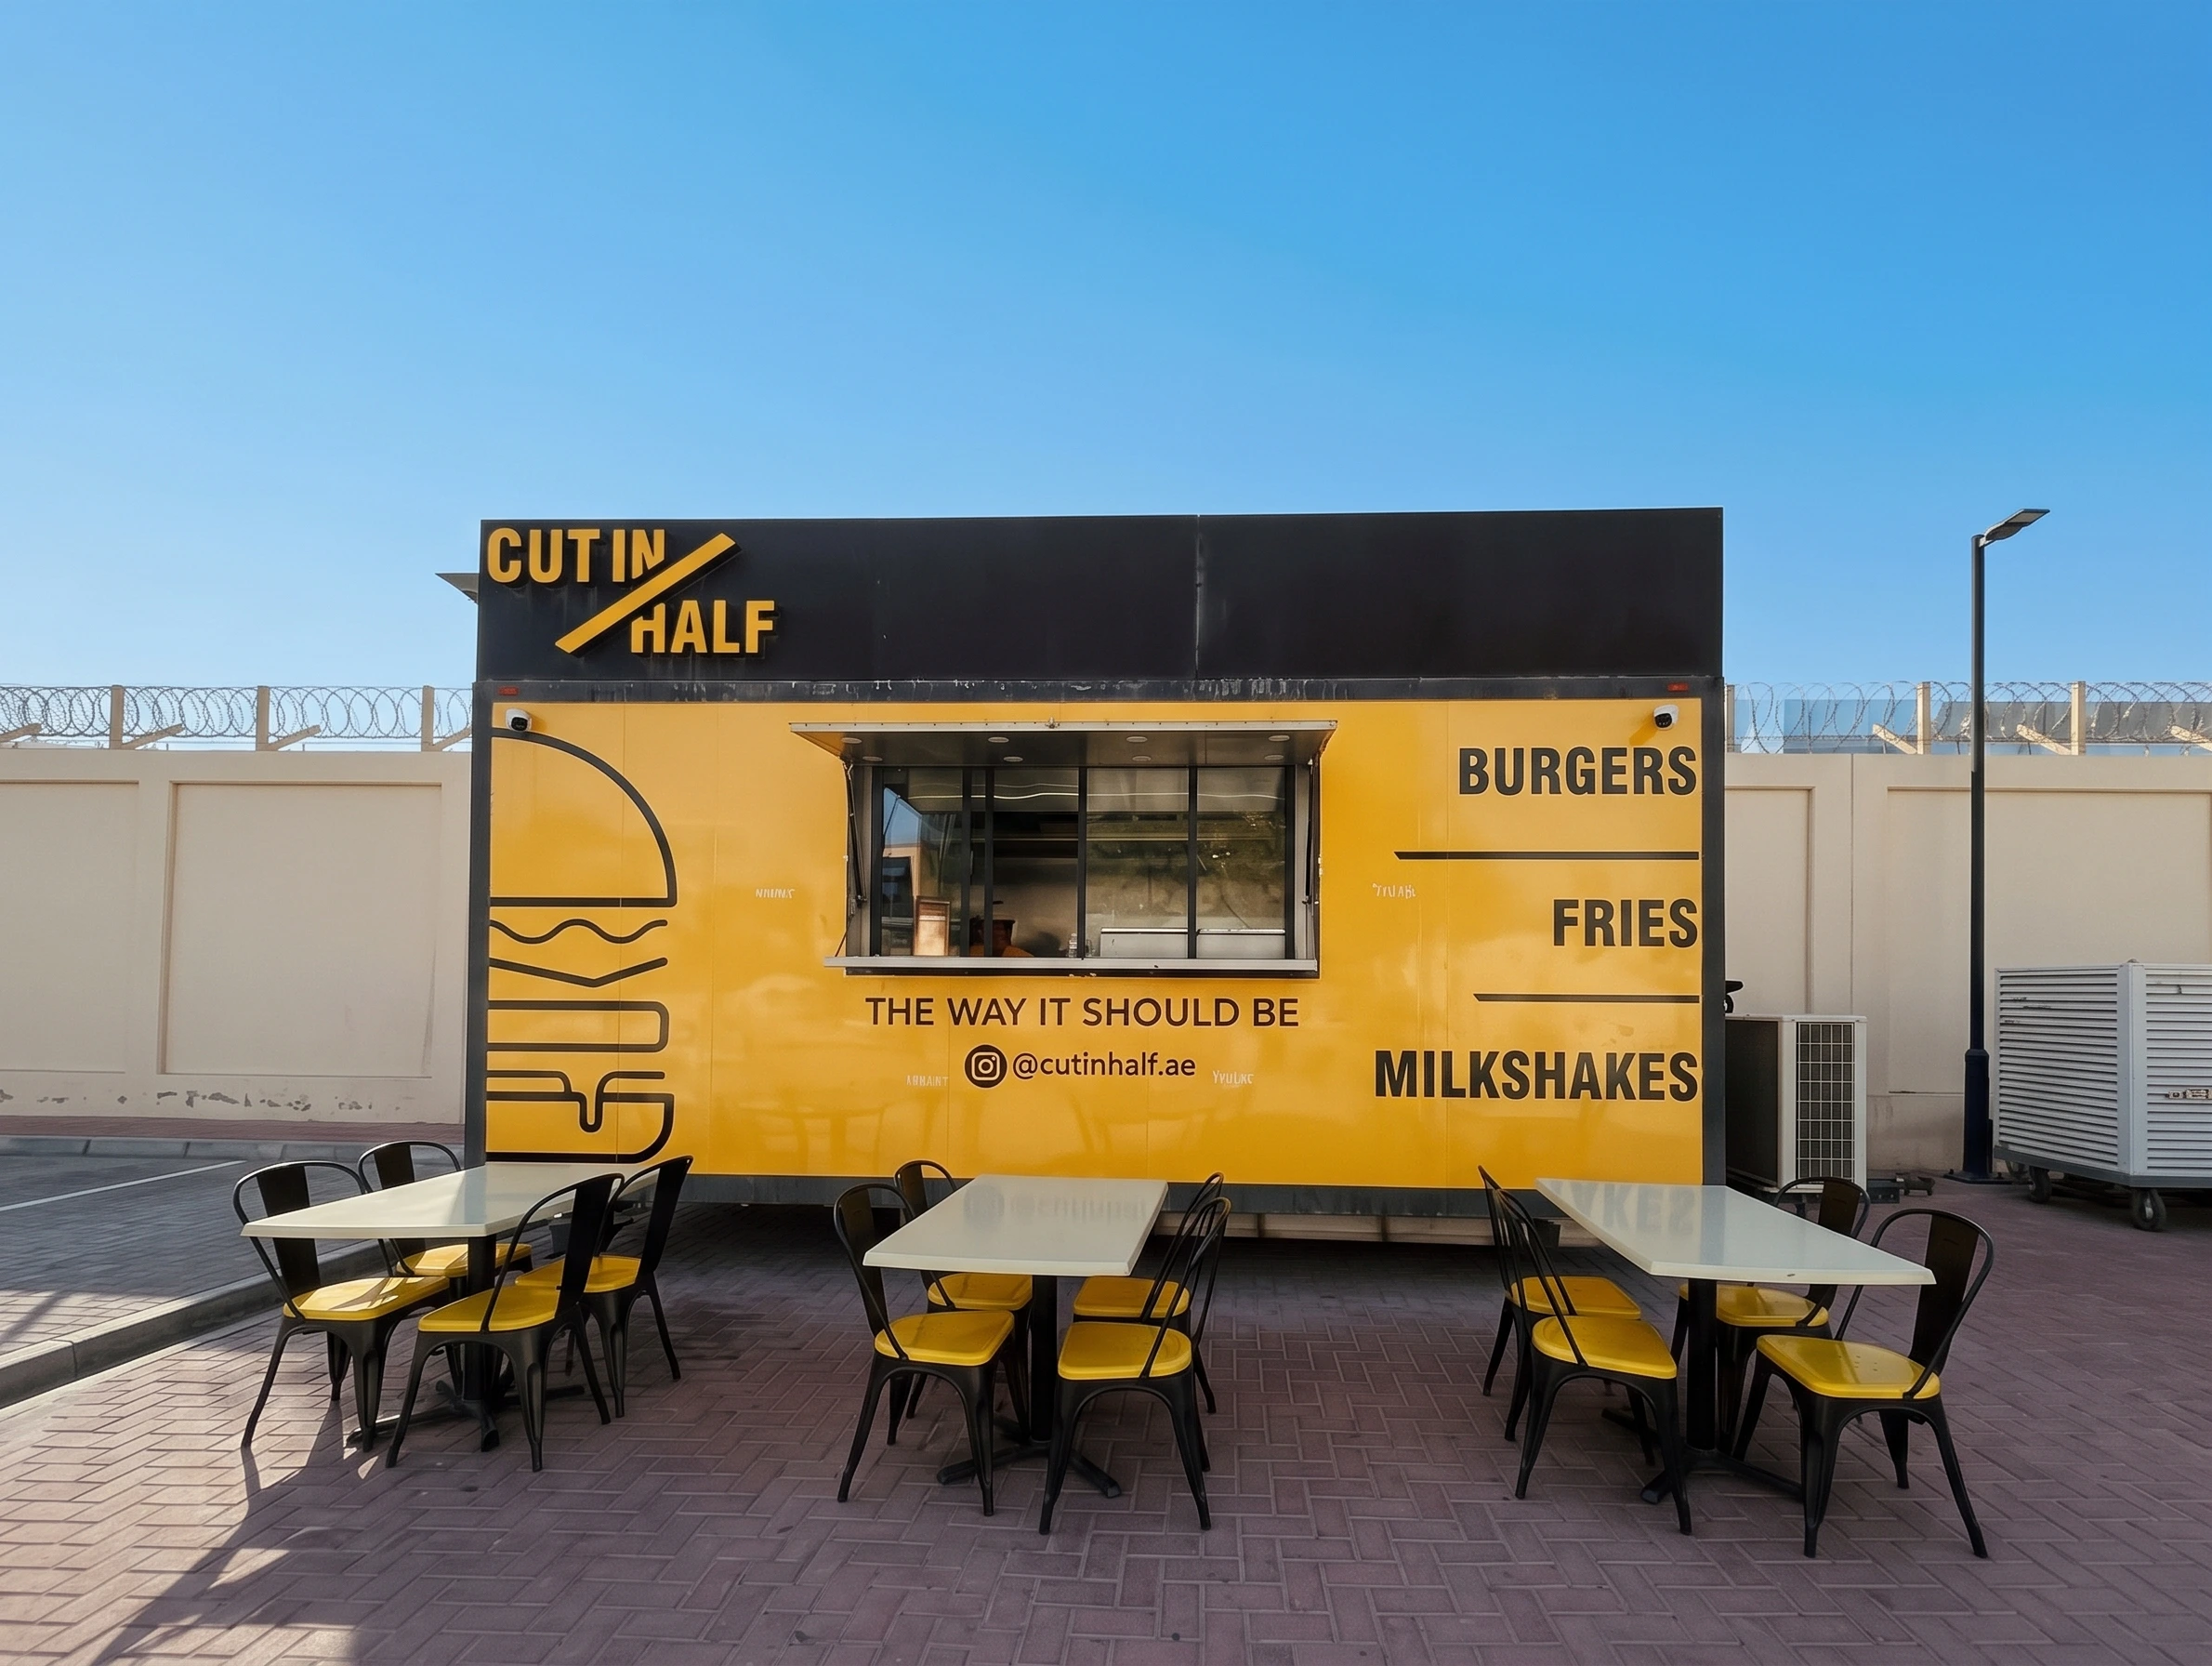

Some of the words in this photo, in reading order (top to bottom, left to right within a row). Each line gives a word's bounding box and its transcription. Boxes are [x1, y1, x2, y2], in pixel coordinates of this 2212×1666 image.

[487, 527, 601, 583] CUT
[612, 529, 666, 582] IN
[631, 600, 775, 654] HALF
[1459, 746, 1698, 797] BURGERS
[1553, 898, 1699, 948] FRIES
[865, 998, 935, 1026] THE
[946, 998, 1028, 1026] WAY
[1039, 998, 1072, 1026] IT
[1083, 997, 1241, 1027] SHOULD
[1252, 998, 1299, 1026] BE
[1012, 1051, 1197, 1080] @cutinhalf.ae
[1375, 1049, 1699, 1102] MILKSHAKES
